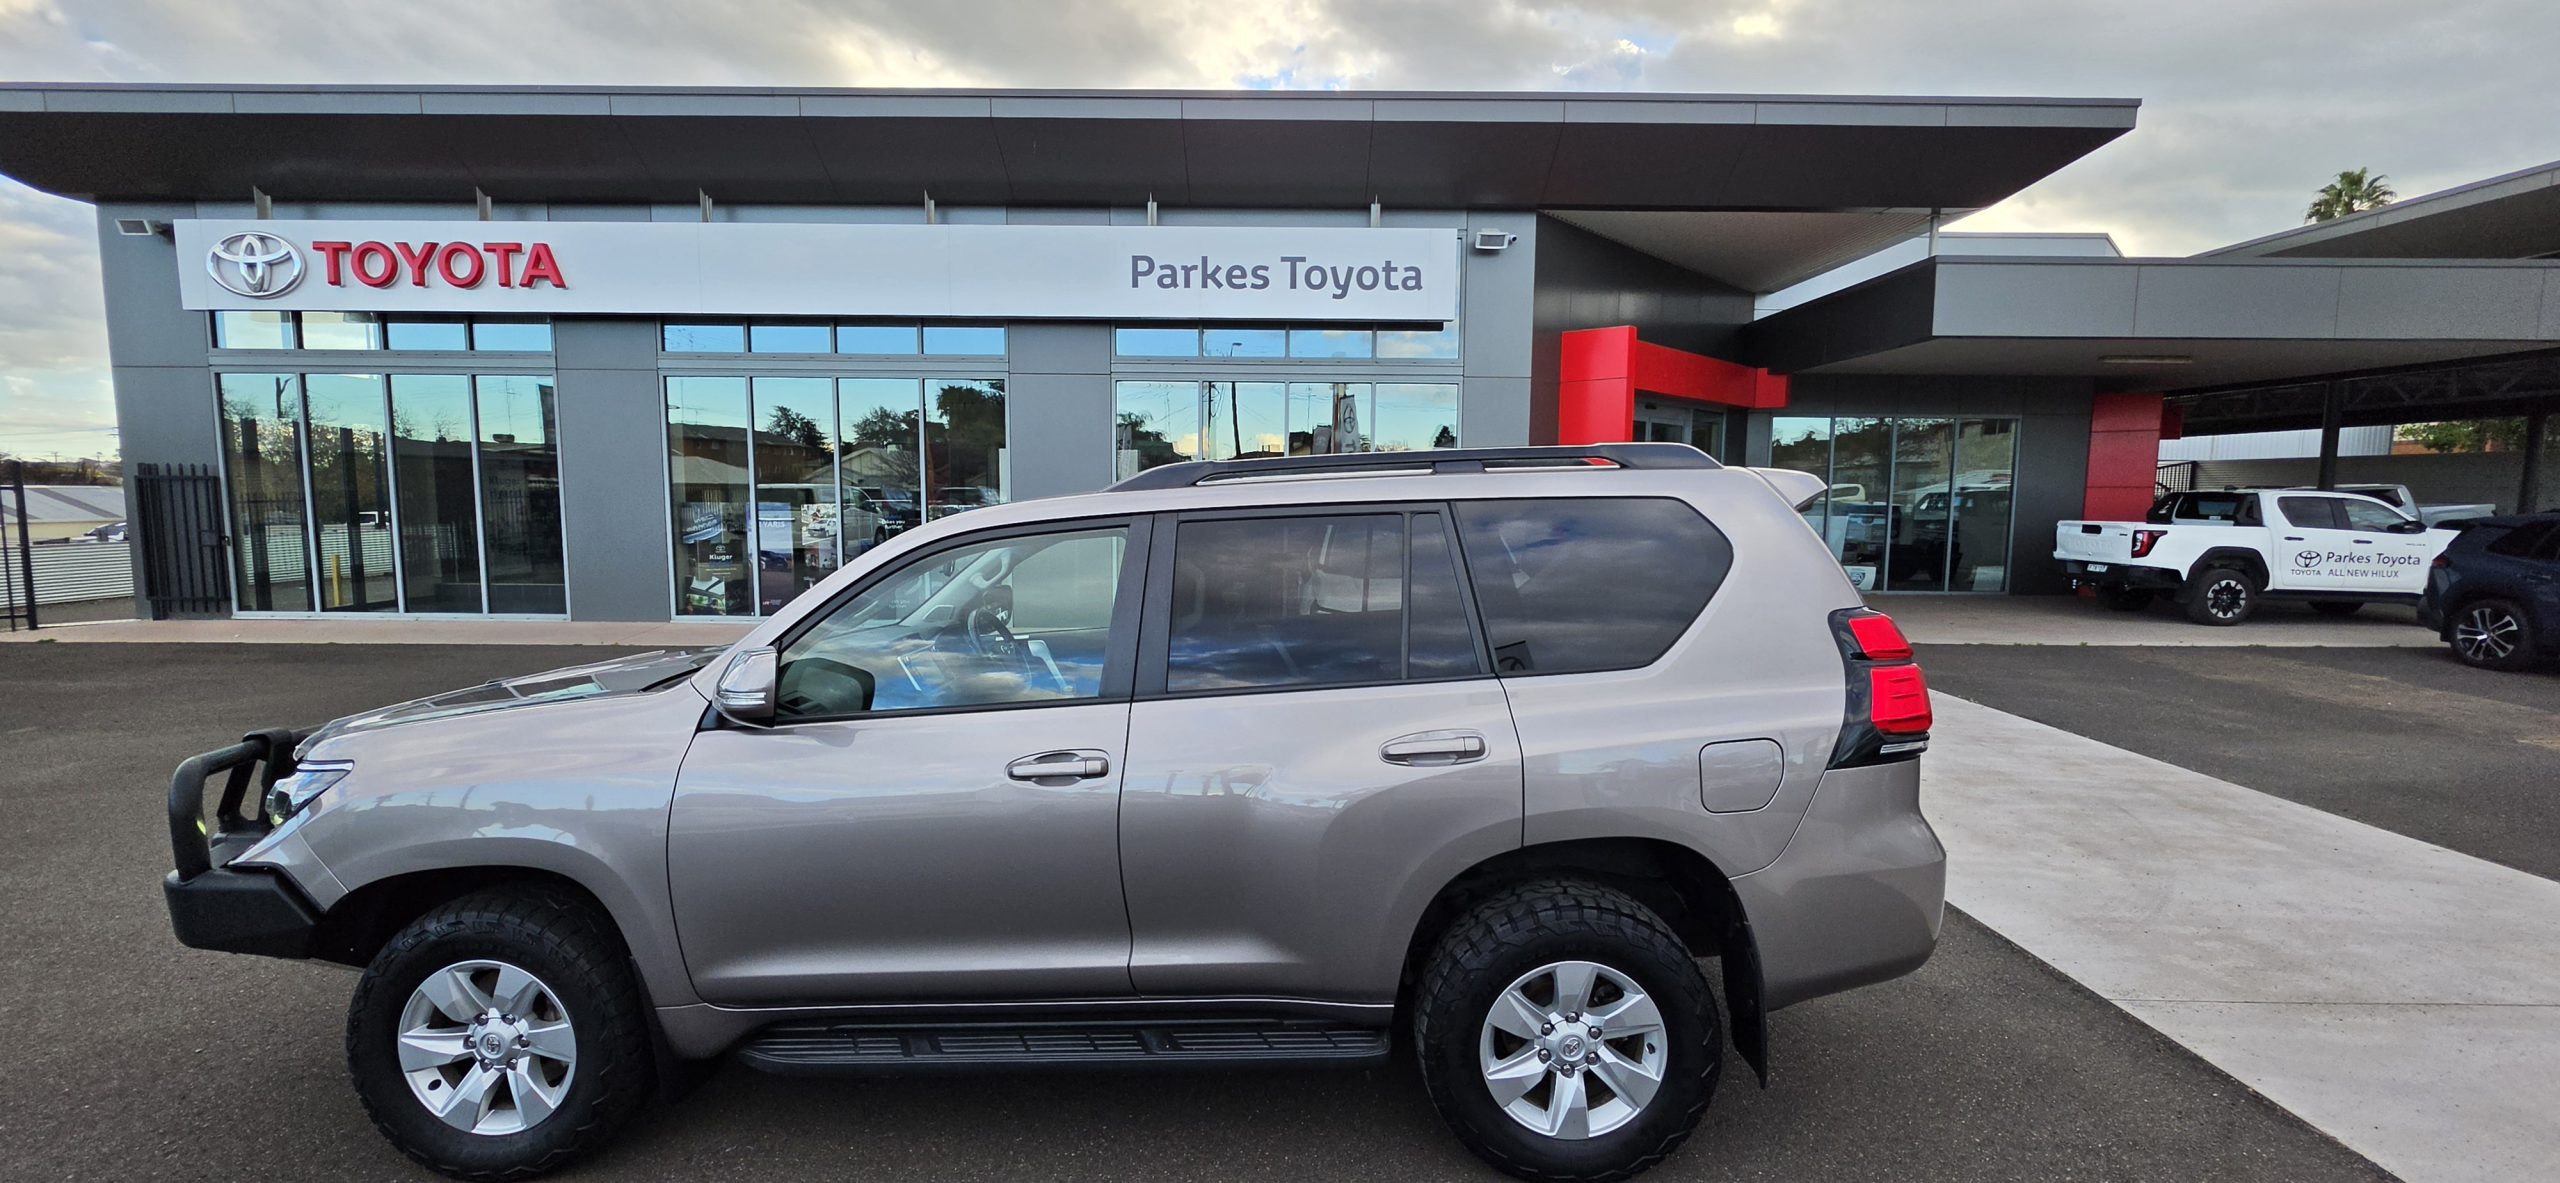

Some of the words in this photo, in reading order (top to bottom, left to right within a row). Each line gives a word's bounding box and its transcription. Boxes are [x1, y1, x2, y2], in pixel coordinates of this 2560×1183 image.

[312, 241, 567, 289] TOYOTA
[1131, 255, 1270, 290] Parkes
[1280, 256, 1423, 300] Toyota
[2326, 551, 2371, 564] Parkes
[2376, 553, 2421, 567] Toyota
[2328, 569, 2345, 577] ALL
[2346, 569, 2369, 577] NEW
[2371, 570, 2399, 578] HILUX
